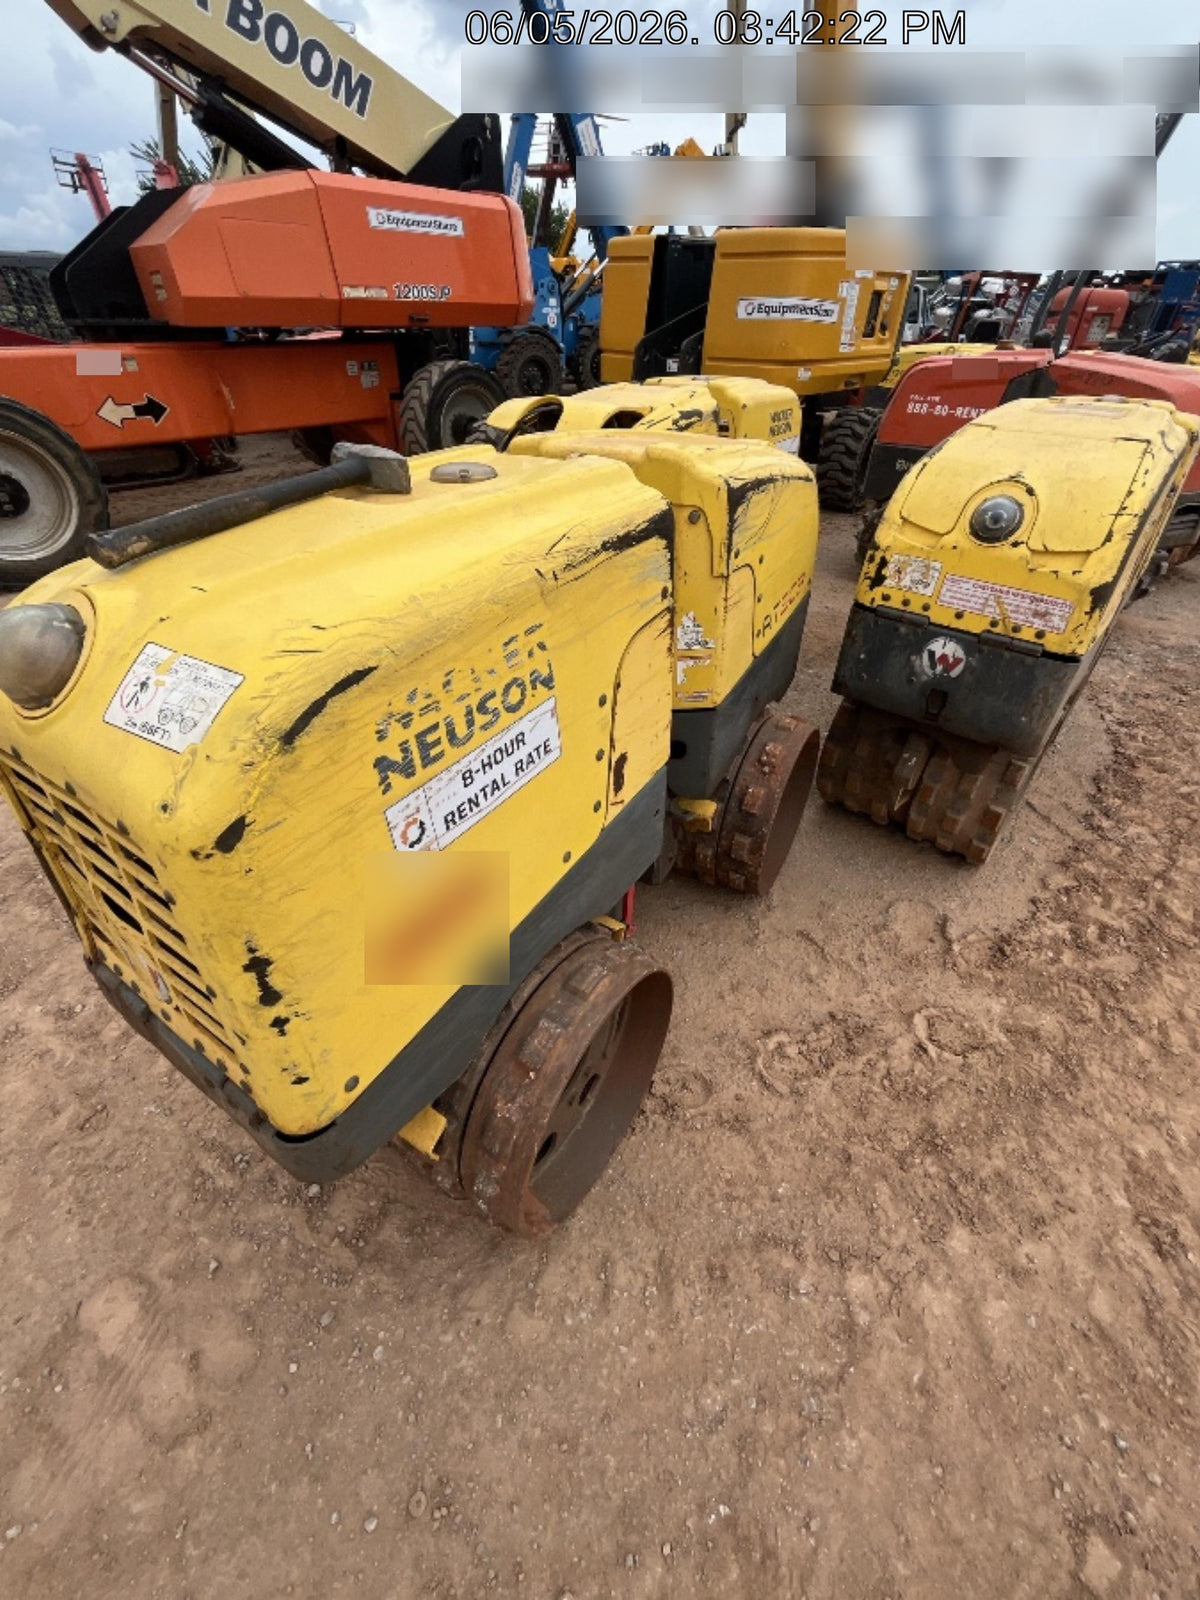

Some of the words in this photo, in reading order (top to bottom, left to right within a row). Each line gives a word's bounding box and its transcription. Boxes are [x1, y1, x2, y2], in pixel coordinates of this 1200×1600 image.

[226, 0, 373, 118] BOOM
[372, 659, 556, 796] NEUSON
[461, 731, 528, 789] 8-HOUR
[443, 773, 511, 832] RENTAL
[514, 737, 554, 777] RATE
